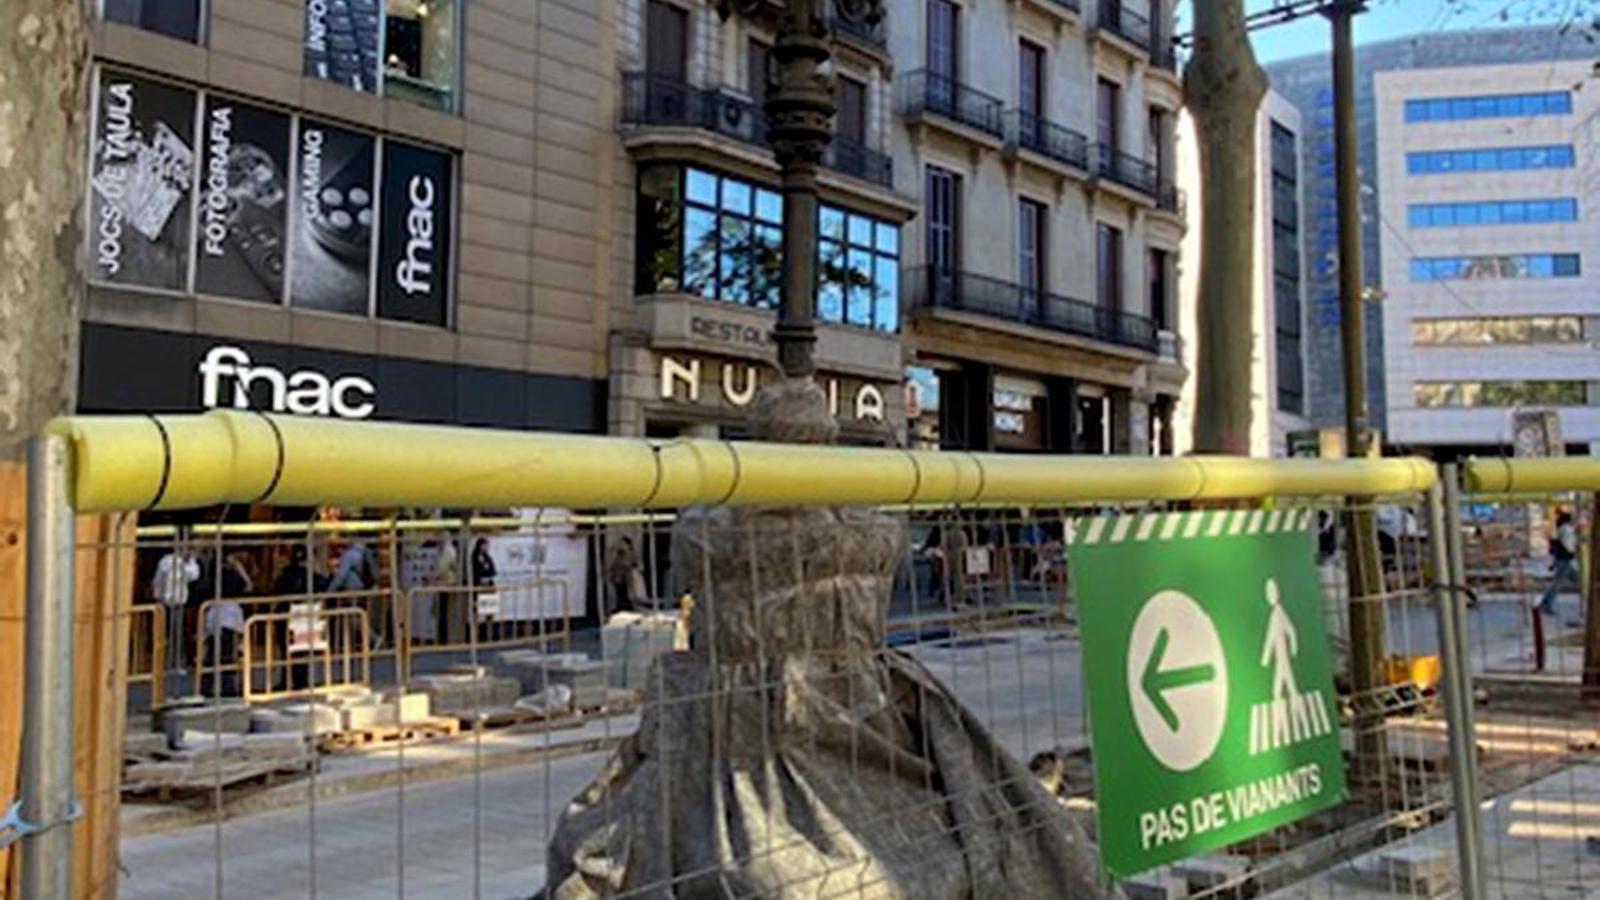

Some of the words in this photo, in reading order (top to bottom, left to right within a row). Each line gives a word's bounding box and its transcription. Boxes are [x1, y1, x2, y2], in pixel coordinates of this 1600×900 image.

[104, 83, 133, 160] TAULA
[108, 162, 128, 204] DE
[205, 107, 233, 255] FOTOGRAFIA
[304, 130, 323, 219] GAMING
[99, 209, 122, 273] JOCS
[397, 175, 434, 295] fnac
[691, 316, 772, 346] RESTAU
[198, 346, 376, 420] fnac
[661, 356, 884, 422] NUIA
[1140, 803, 1190, 850] PAS
[1192, 791, 1228, 832] DE
[1227, 763, 1323, 822] VIANANTS
